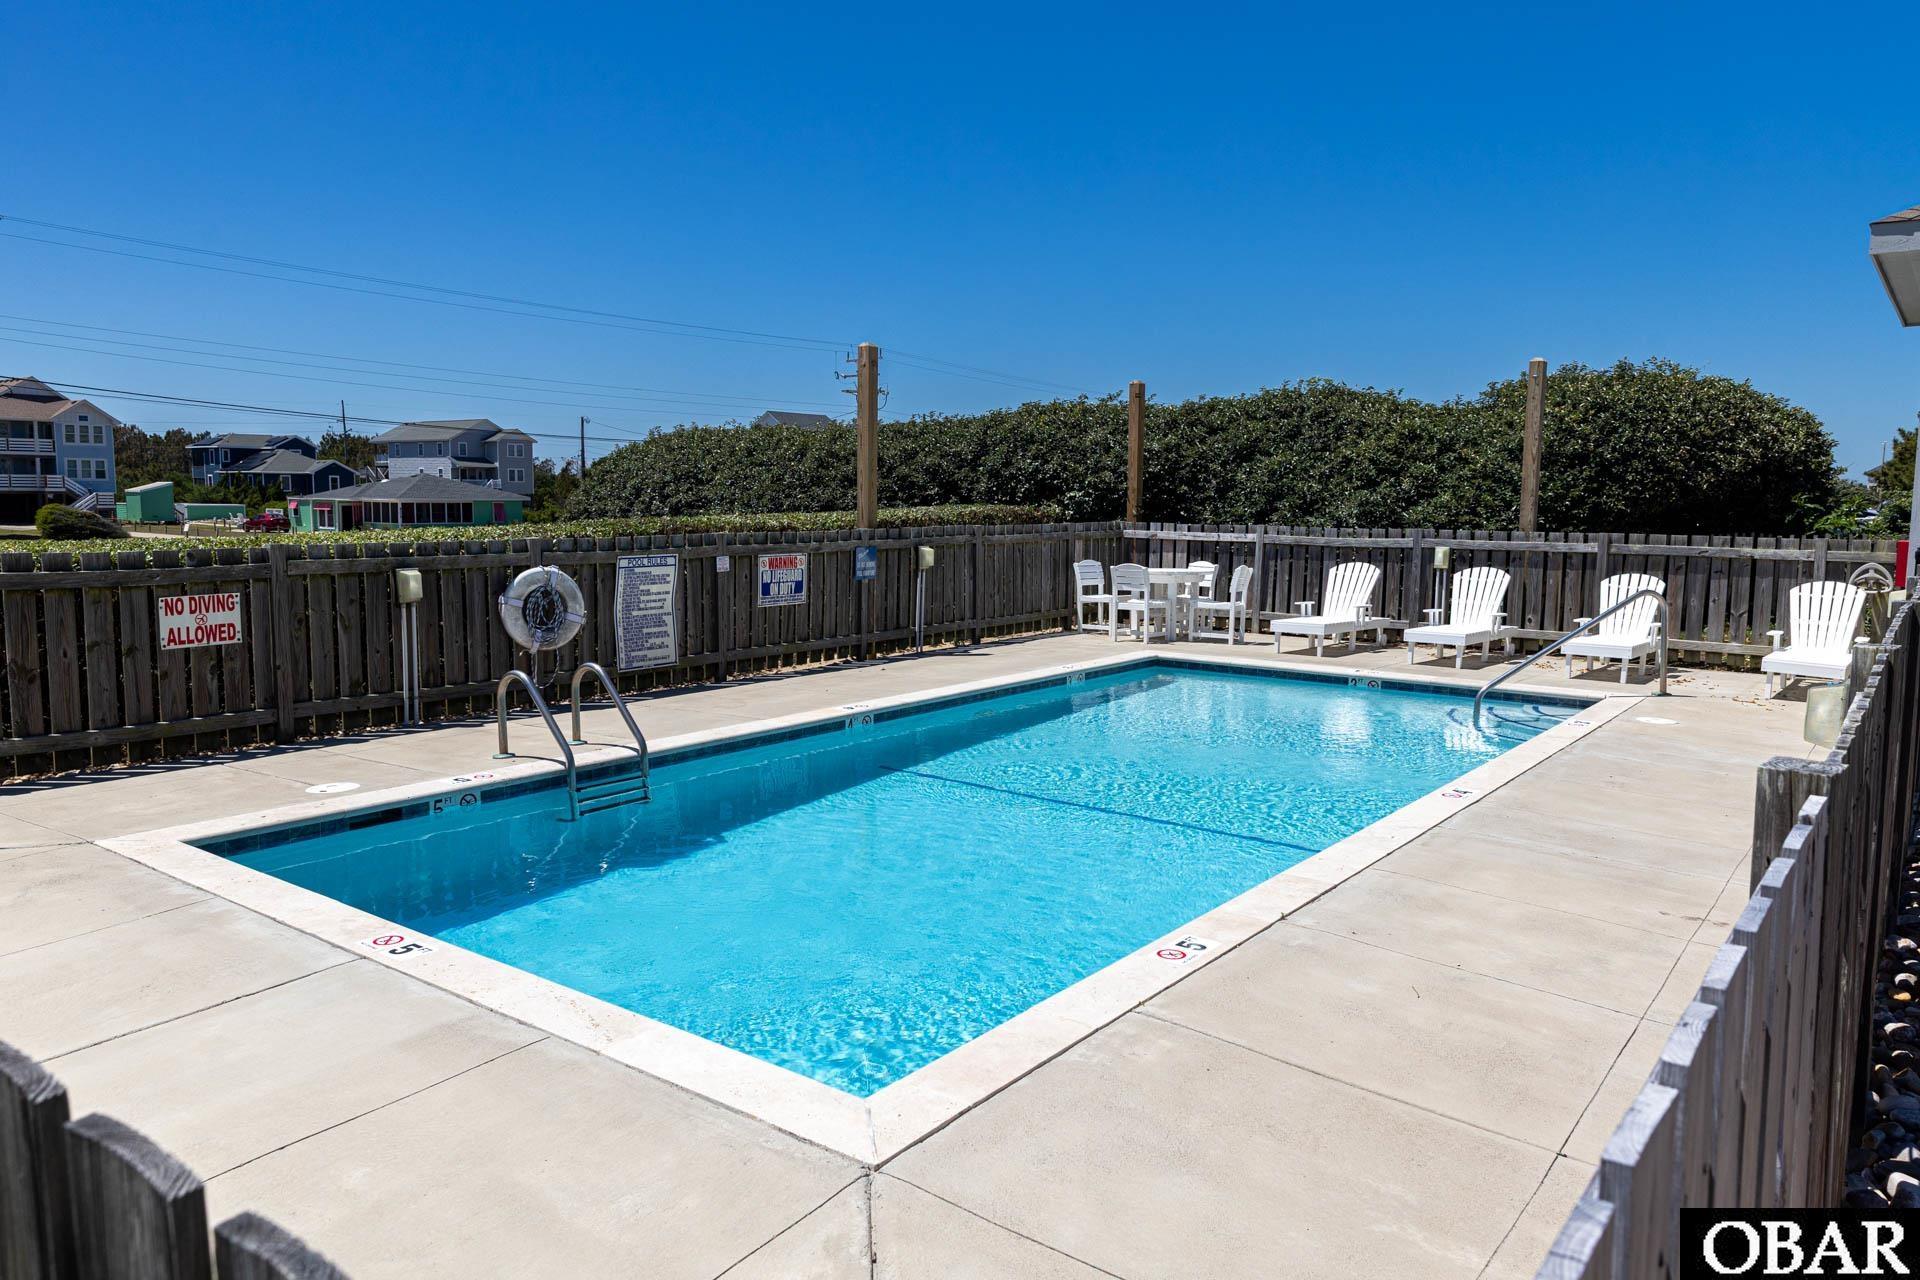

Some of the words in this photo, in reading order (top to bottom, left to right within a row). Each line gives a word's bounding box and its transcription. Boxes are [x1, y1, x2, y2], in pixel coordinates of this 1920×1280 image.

[627, 558, 646, 567] POOL
[647, 557, 668, 566] RULES
[768, 555, 798, 570] WARNING
[762, 570, 772, 584] NO
[772, 568, 803, 583] LIFEGUARD
[770, 582, 779, 596] ON
[779, 581, 796, 596] DUTY
[164, 597, 184, 616] NO
[189, 593, 236, 615] DIVING
[166, 622, 237, 647] ALLOWED
[433, 798, 443, 814] 5
[388, 943, 423, 955] 5
[1175, 940, 1207, 951] 5
